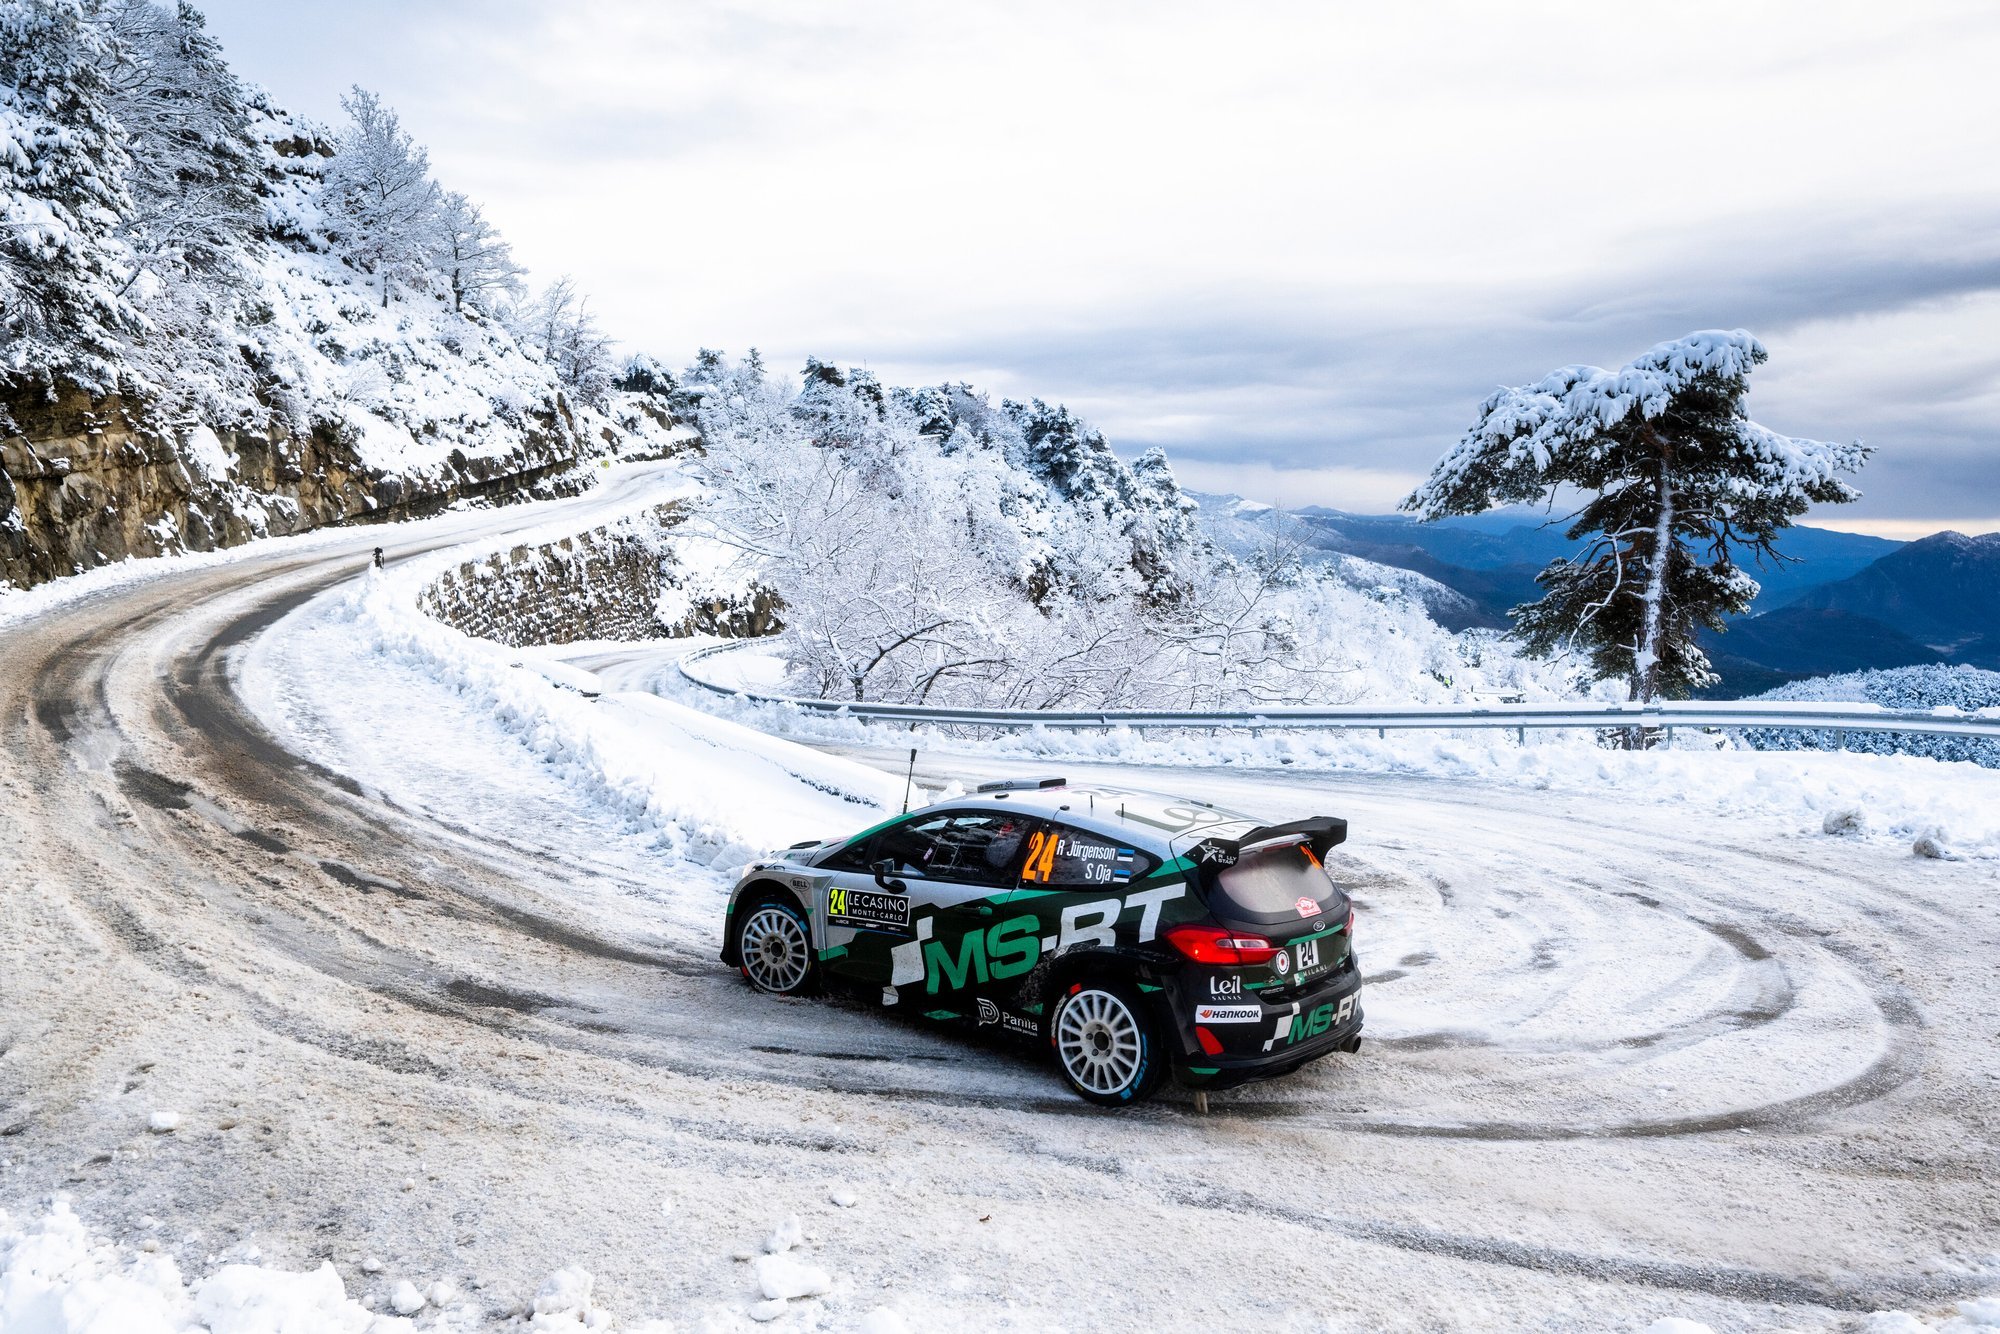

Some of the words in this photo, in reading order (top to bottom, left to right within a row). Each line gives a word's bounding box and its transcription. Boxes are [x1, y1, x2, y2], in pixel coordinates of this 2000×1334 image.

[1022, 831, 1059, 882] 24
[1056, 839, 1065, 856] R
[1067, 840, 1116, 861] Jürgenson
[792, 879, 808, 888] BELL
[1085, 863, 1093, 879] S
[1095, 863, 1111, 884] Oja
[830, 889, 846, 915] 24
[848, 893, 860, 906] LE
[861, 895, 907, 912] CASINO
[852, 908, 903, 921] MONTE-CARLO
[924, 882, 1187, 995] MS-RT
[1301, 940, 1314, 967] 24
[1302, 965, 1327, 977] MILANI
[1210, 975, 1241, 994] Leil
[1287, 987, 1361, 1045] MS-RT
